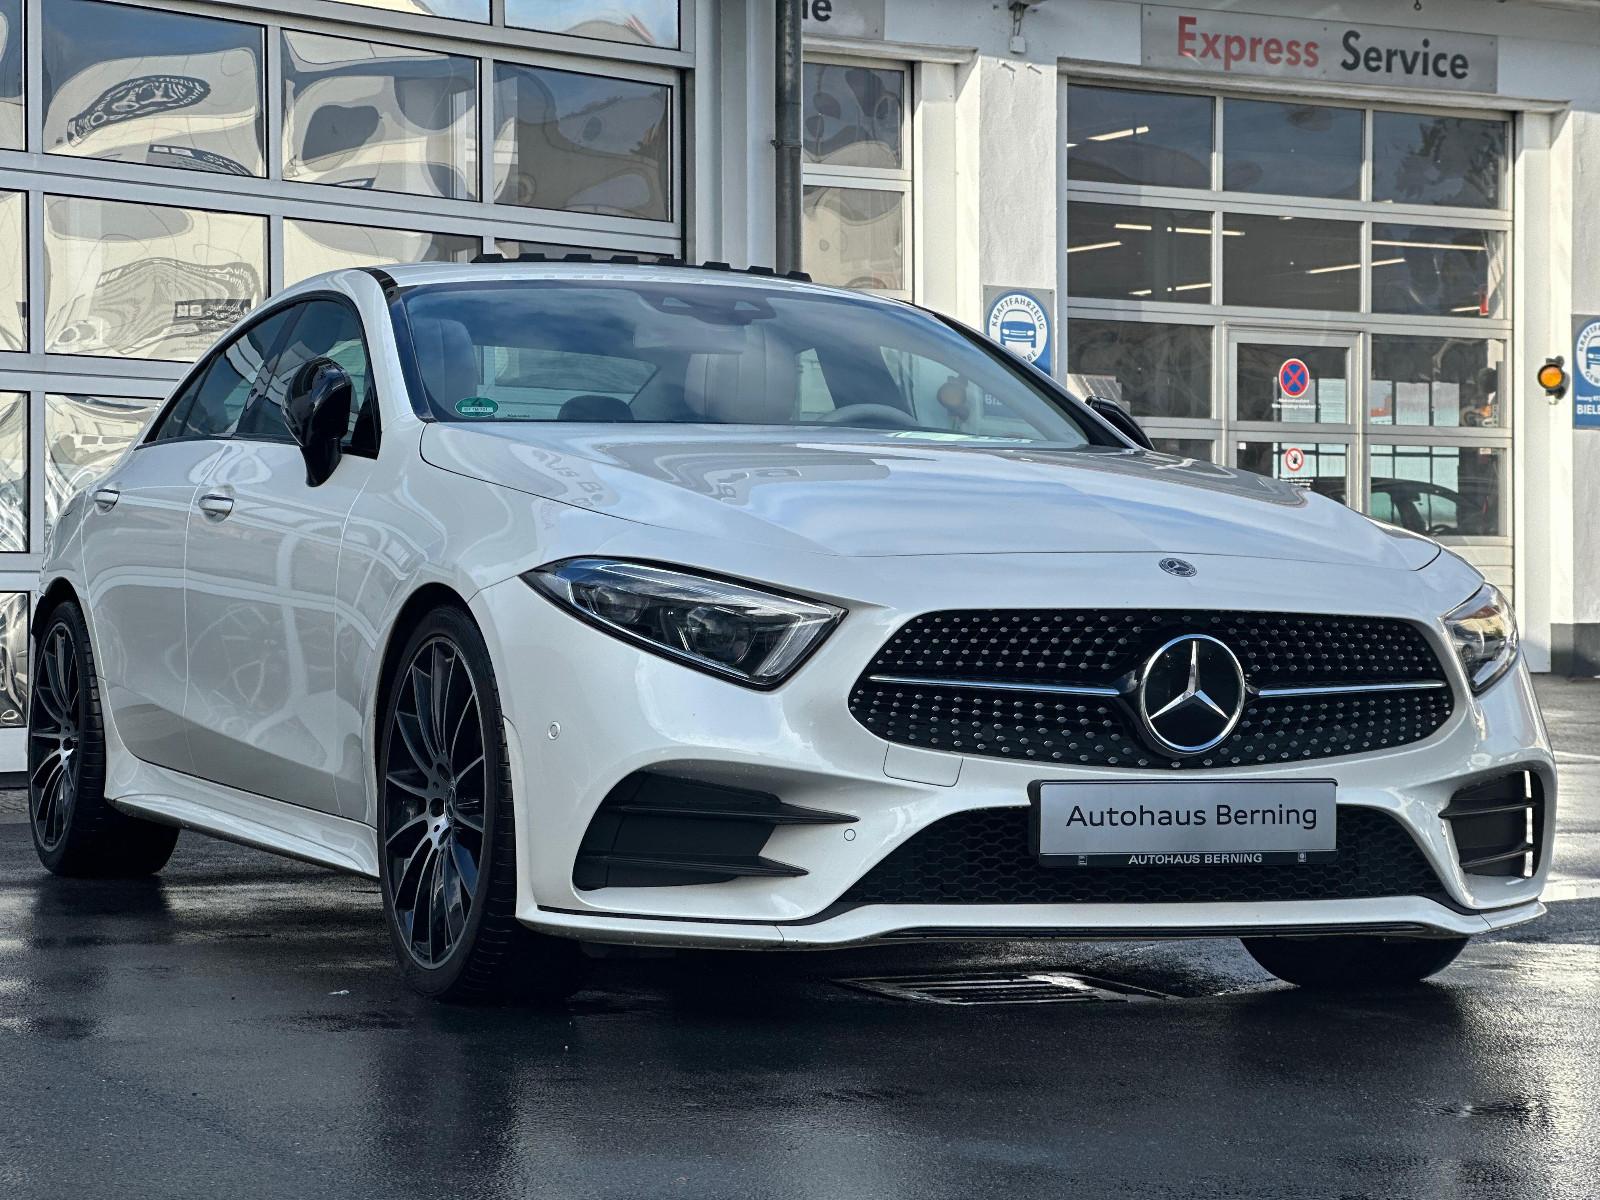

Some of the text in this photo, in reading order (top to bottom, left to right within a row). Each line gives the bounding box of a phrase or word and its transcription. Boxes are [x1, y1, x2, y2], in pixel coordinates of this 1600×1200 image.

[1178, 15, 1469, 80] Express Service
[991, 297, 1046, 330] KRAFTFAHRZEUG
[1065, 803, 1318, 830] Autohaus Berning
[1127, 853, 1264, 865] AUTOHAUS BERNING
